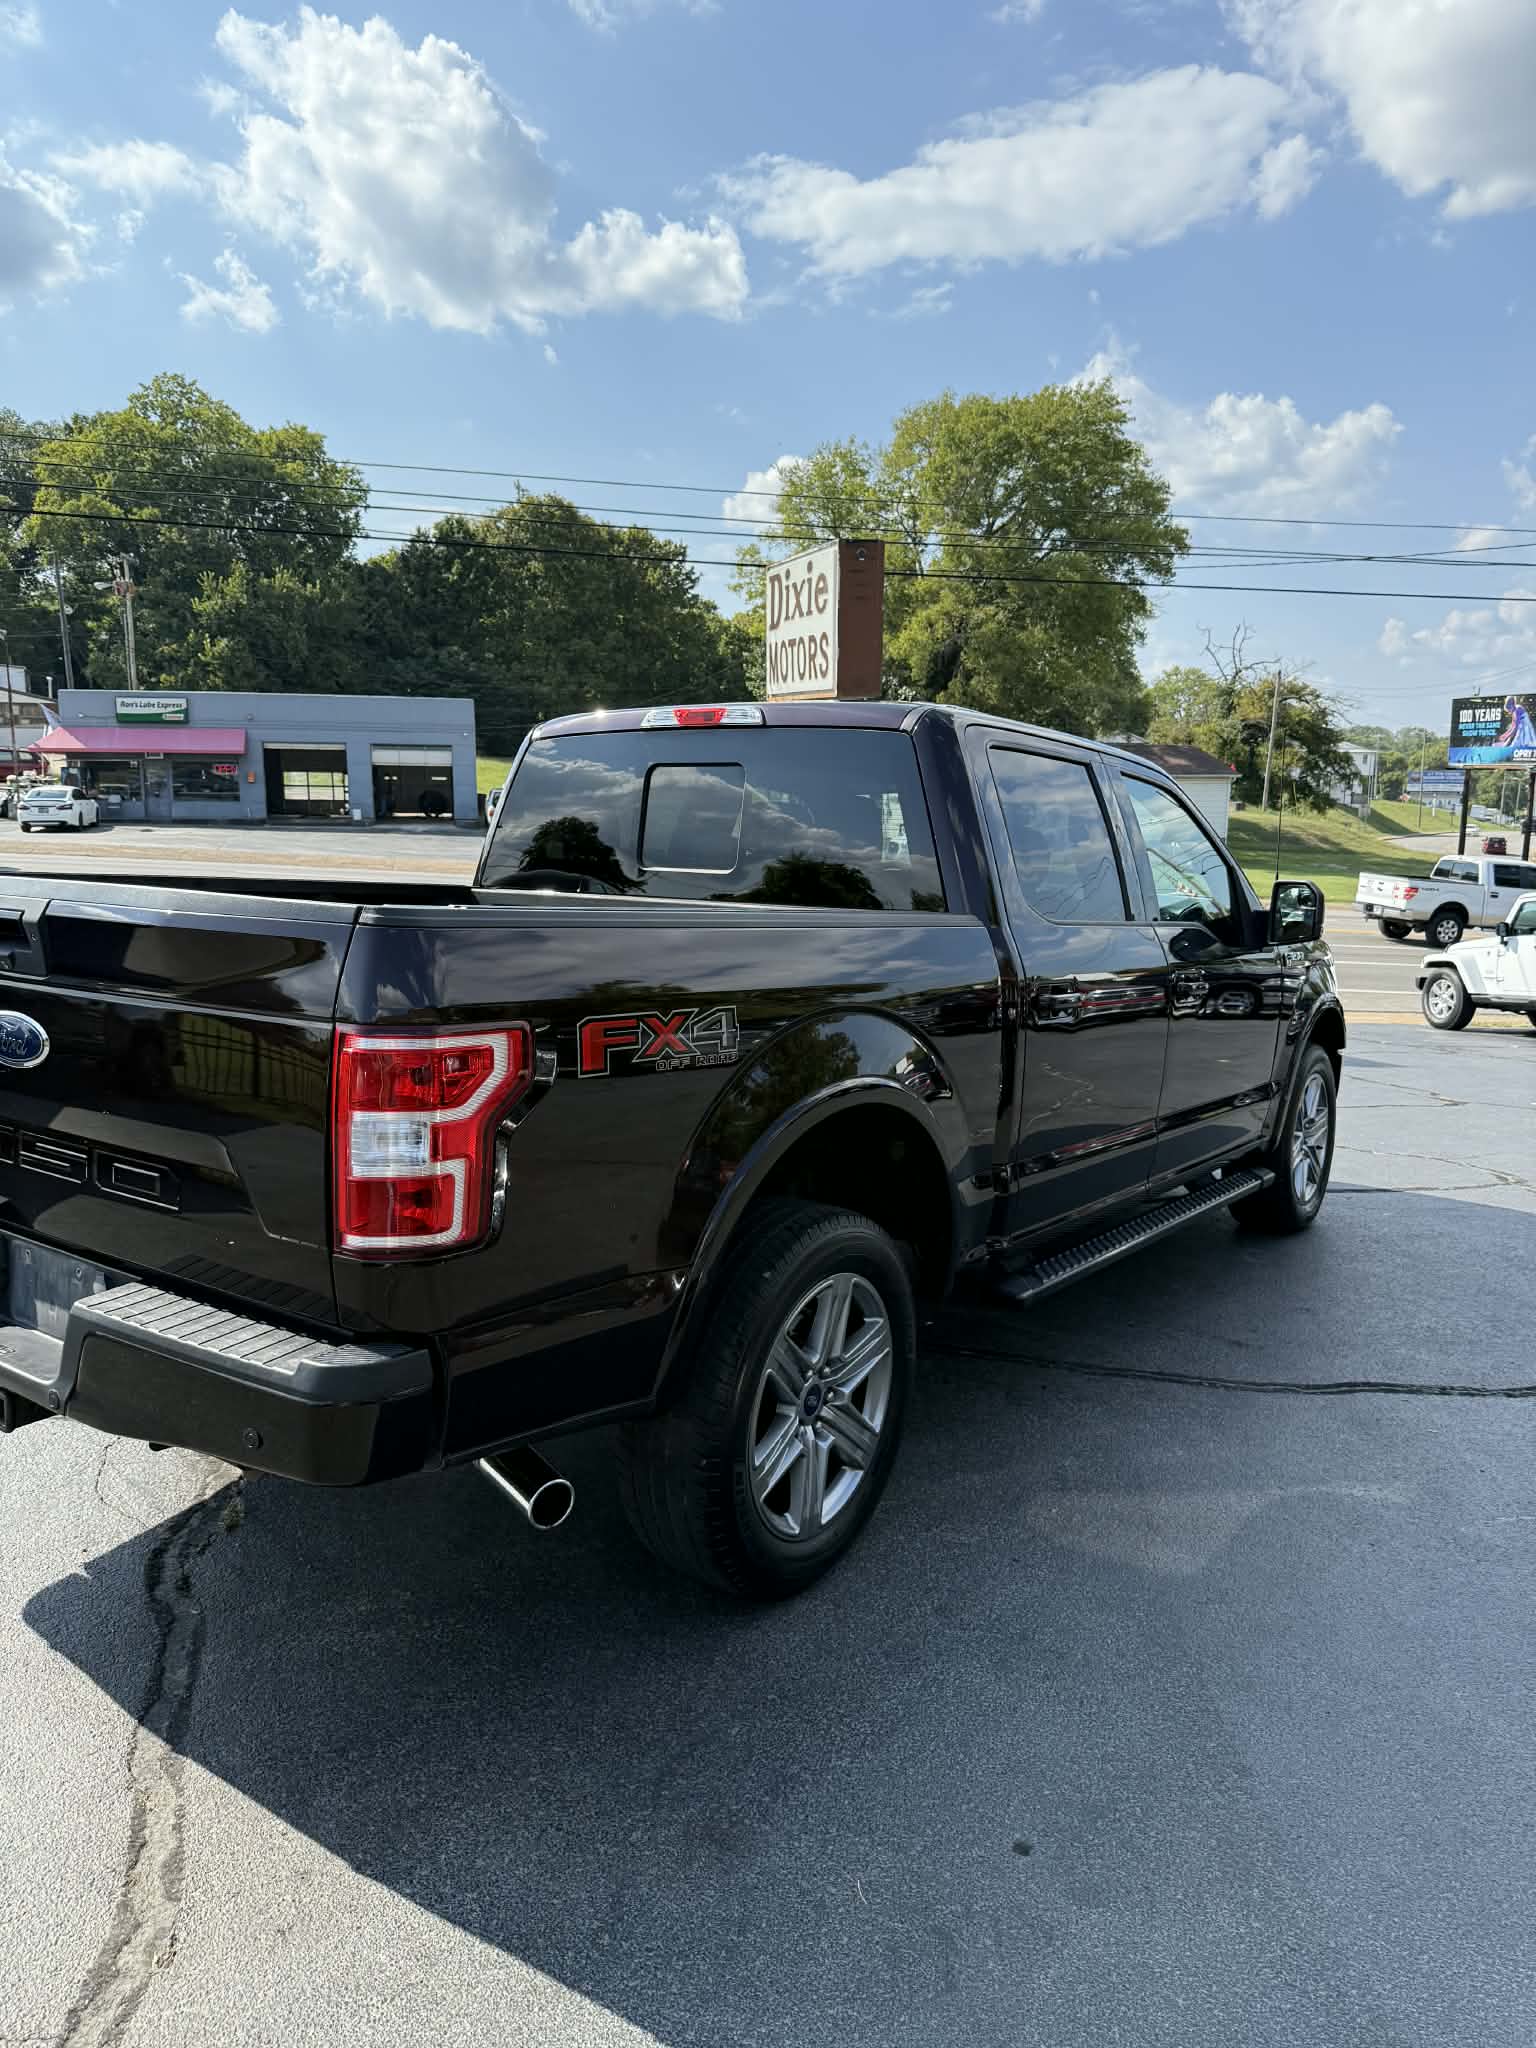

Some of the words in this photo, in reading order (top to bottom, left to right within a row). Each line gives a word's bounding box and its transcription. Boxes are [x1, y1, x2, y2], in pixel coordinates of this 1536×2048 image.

[768, 560, 829, 632] Dixie
[768, 631, 830, 686] MOTORS
[139, 700, 156, 708] Lube
[157, 701, 183, 709] Express
[1459, 709, 1473, 723] 100
[1474, 708, 1502, 722] YEARS
[576, 1005, 740, 1079] FX4
[655, 1056, 691, 1072] OFF
[696, 1051, 739, 1067] ROAD
